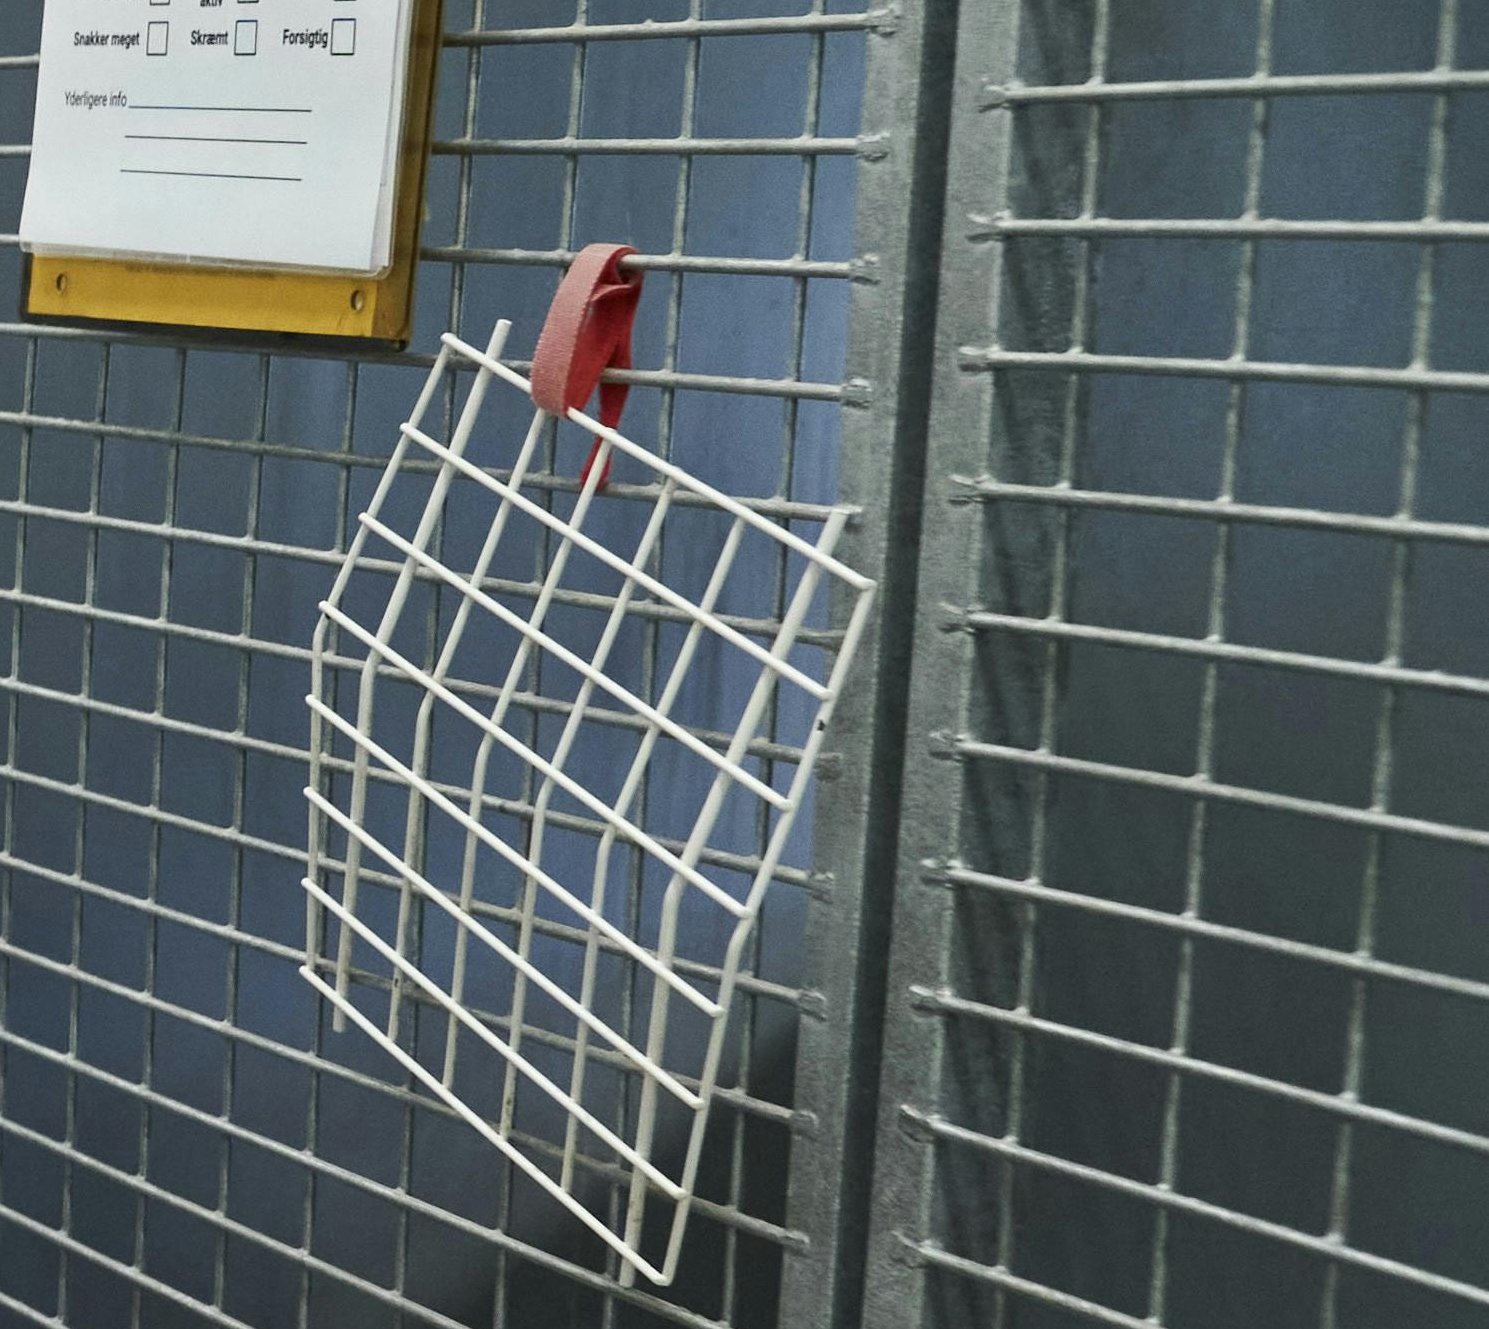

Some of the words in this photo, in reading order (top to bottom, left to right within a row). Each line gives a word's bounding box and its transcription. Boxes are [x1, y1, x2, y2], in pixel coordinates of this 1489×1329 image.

[73, 31, 109, 46] Snakker
[111, 32, 140, 50] meget
[190, 30, 228, 45] Skræmt
[282, 29, 328, 48] Forsigtig
[64, 91, 107, 110] Yderligere
[109, 91, 127, 107] info
